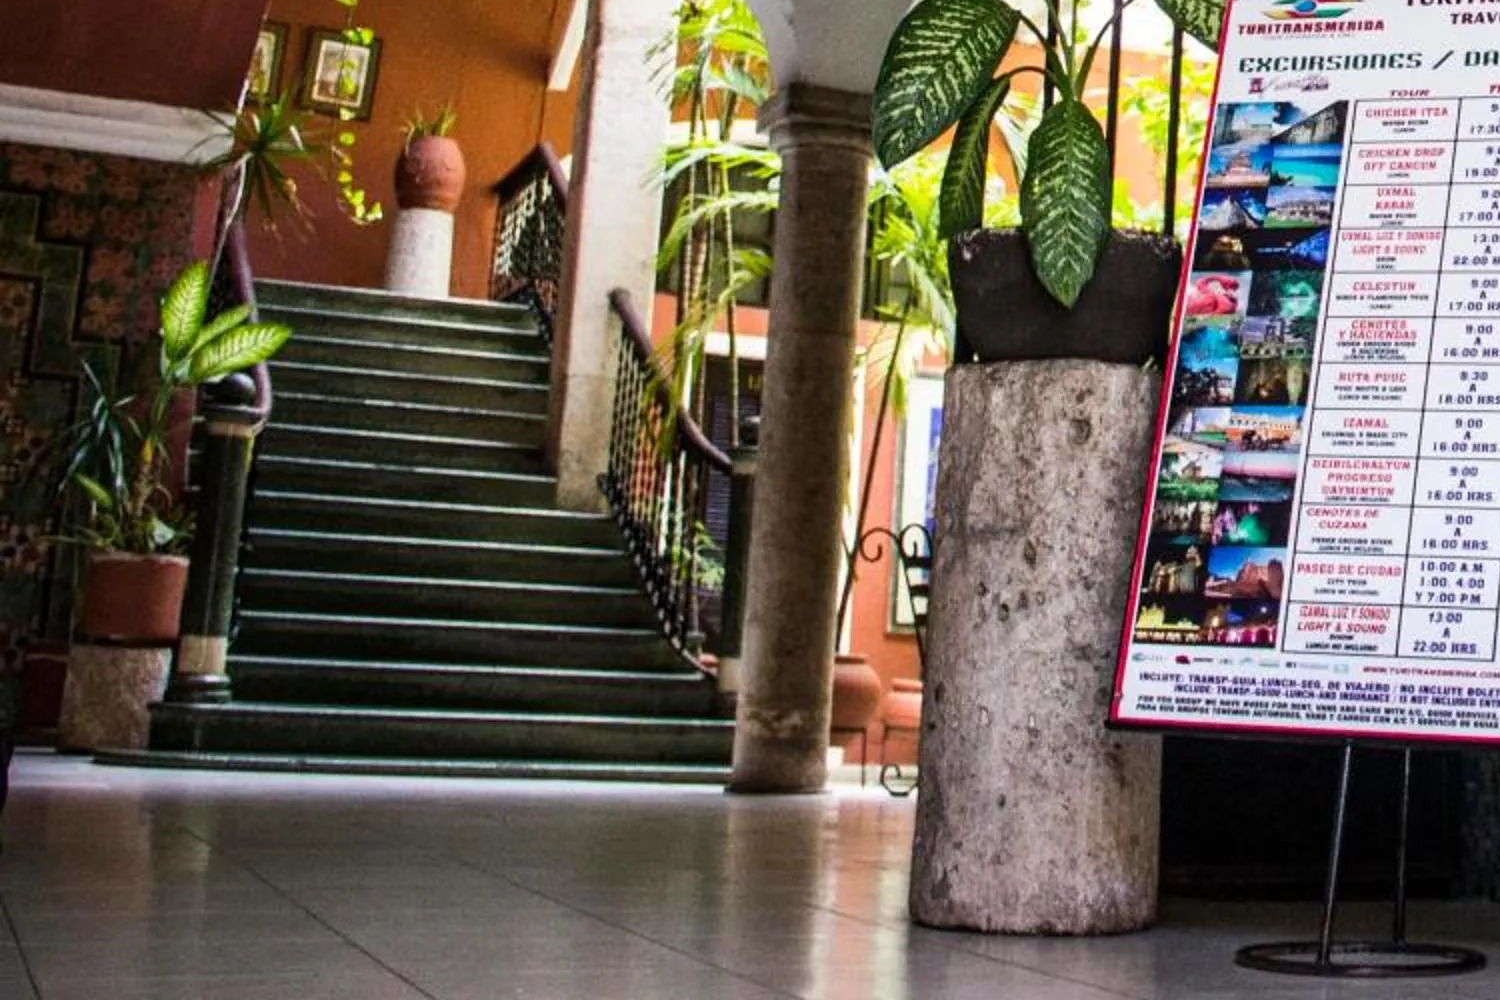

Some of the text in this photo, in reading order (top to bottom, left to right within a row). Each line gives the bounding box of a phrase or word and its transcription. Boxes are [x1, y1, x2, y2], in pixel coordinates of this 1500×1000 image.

[1238, 19, 1385, 36] TURITRANSMERIDA
[1239, 52, 1423, 73] EXCURSIONES
[1365, 106, 1449, 118] CHICHEN ITZA
[1376, 187, 1416, 197] UXMAL
[1491, 200, 1499, 210] A
[1484, 246, 1492, 254] A
[1352, 281, 1416, 292] CELESTUN
[1479, 291, 1487, 299] A
[1350, 331, 1417, 340] HACIENDAS
[1338, 372, 1408, 383] RUTA PUUC
[1469, 383, 1477, 393] A
[1343, 417, 1389, 428] IZAMAL
[1463, 431, 1472, 441] A
[1326, 472, 1393, 484] PROGRESO
[1458, 479, 1467, 489] A
[1306, 507, 1361, 518] CENOTES
[1318, 520, 1368, 530] CUZAMA
[1453, 527, 1462, 538] A
[1297, 563, 1402, 577] PASEO DE CIUDAD
[1416, 592, 1422, 602] Y
[1297, 621, 1332, 632] LIGHT
[1346, 623, 1387, 635] SOUND
[1442, 628, 1450, 638] A
[1328, 681, 1340, 690] DE
[1345, 681, 1390, 692] VIAJERO
[1400, 684, 1415, 694] NO
[1418, 685, 1463, 696] INCLUYE
